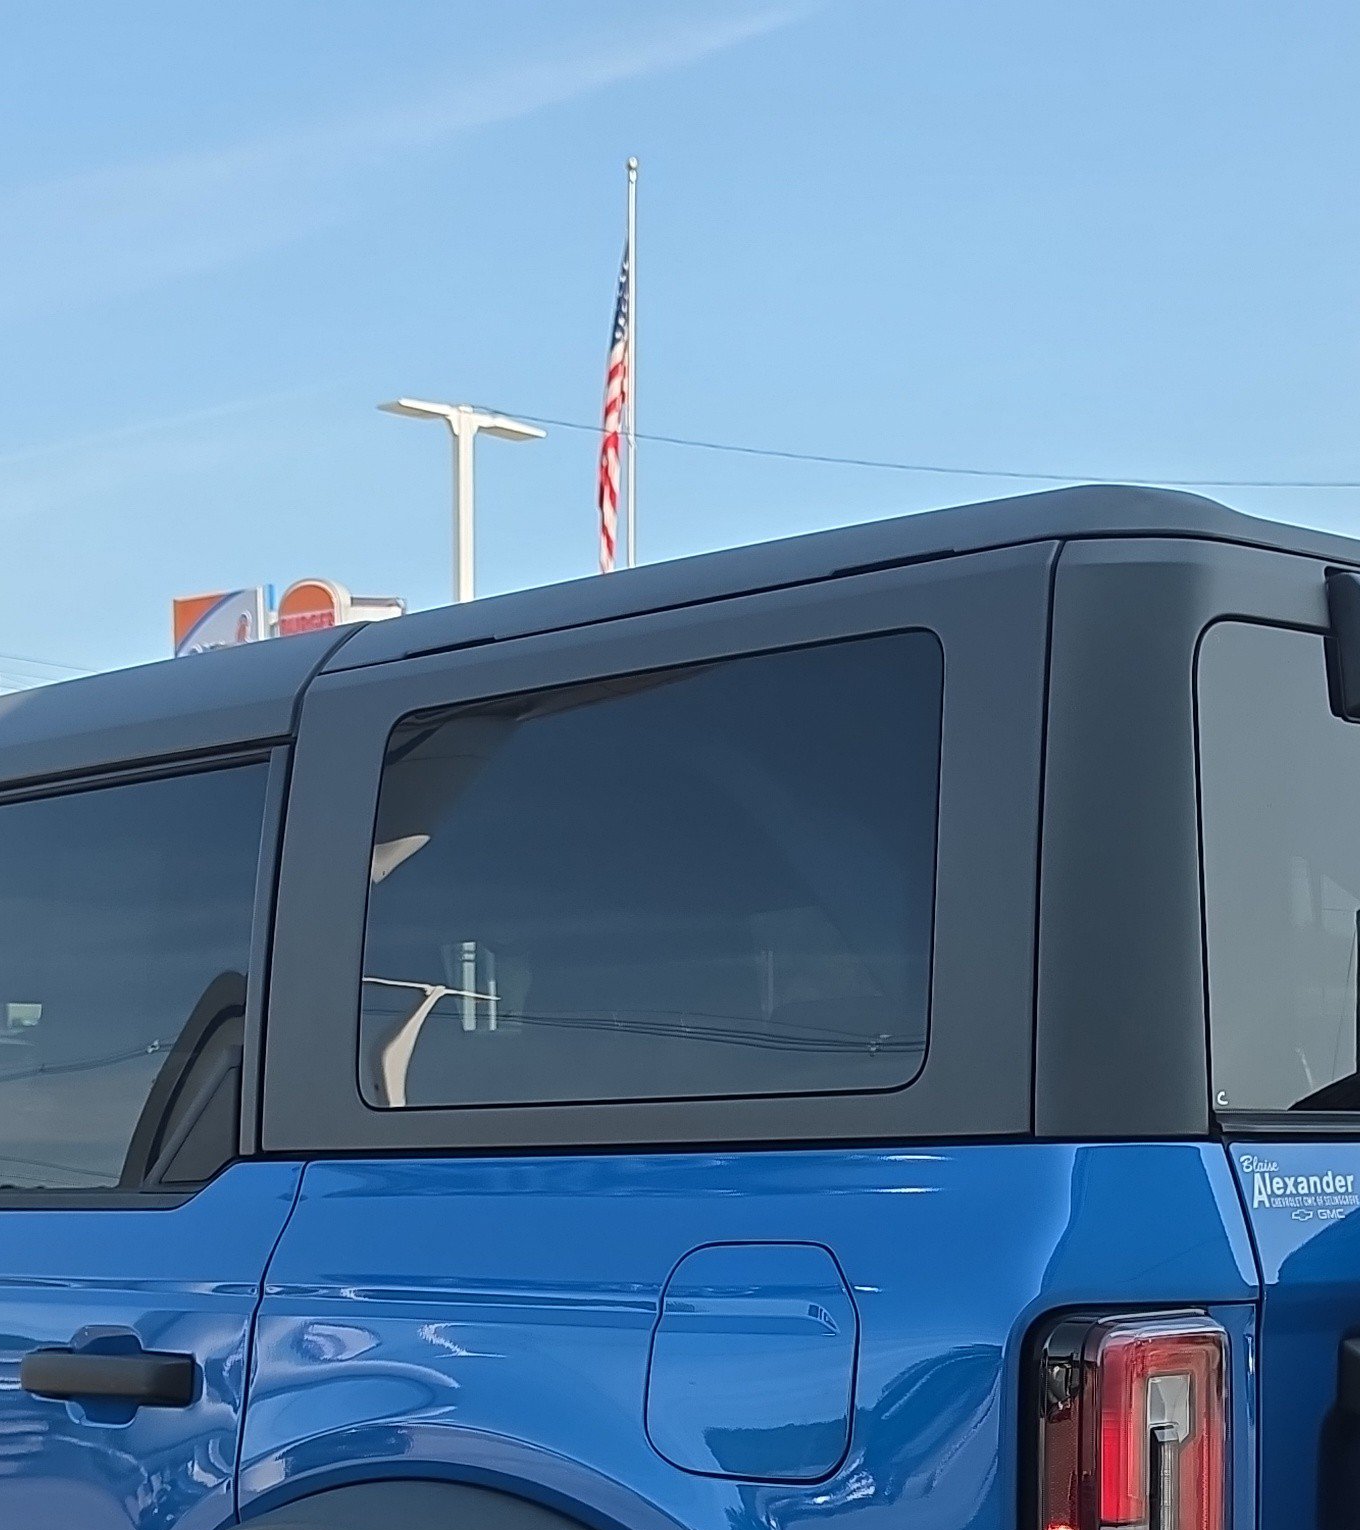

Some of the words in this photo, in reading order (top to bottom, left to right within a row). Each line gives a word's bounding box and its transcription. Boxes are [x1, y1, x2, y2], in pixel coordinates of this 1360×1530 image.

[1239, 1154, 1280, 1173] Blaise
[1252, 1170, 1354, 1209] Alexander
[1317, 1208, 1346, 1220] GMC
